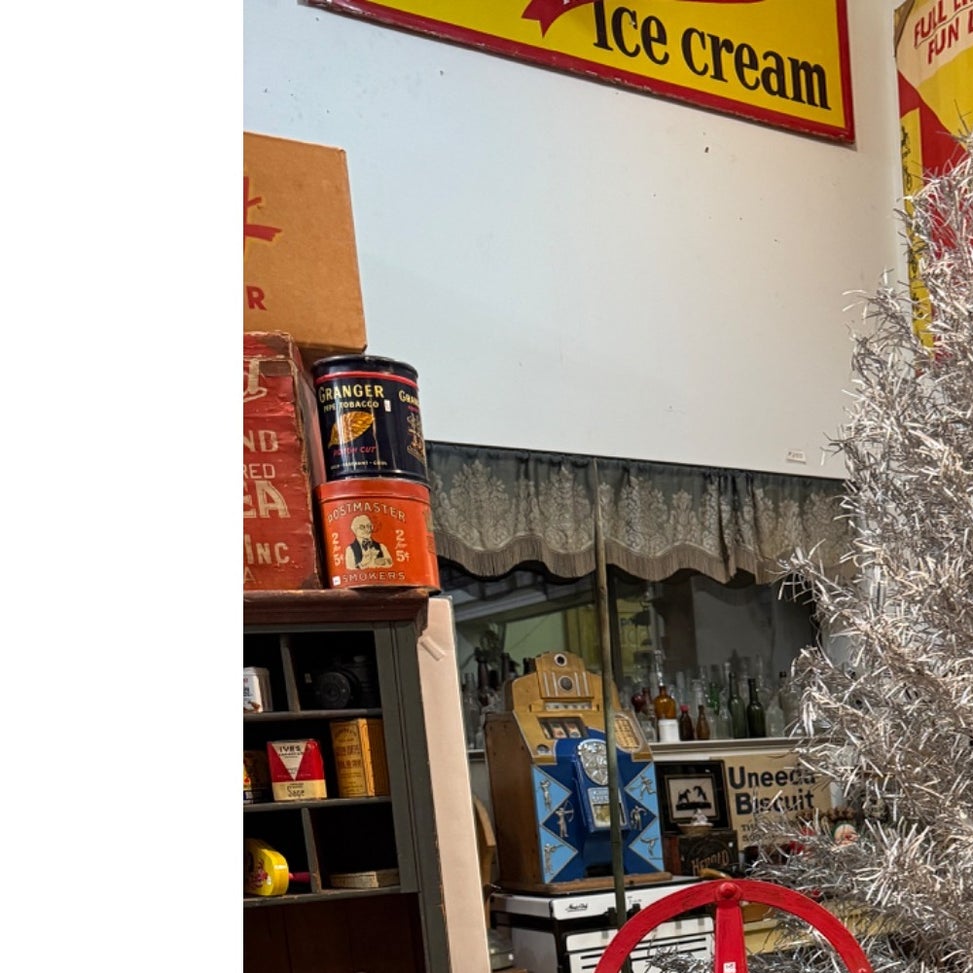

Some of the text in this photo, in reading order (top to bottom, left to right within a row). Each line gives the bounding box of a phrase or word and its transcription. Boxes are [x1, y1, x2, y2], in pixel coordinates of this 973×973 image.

[914, 0, 947, 49] FULL
[927, 17, 960, 64] FUN
[681, 27, 832, 111] cream
[318, 384, 384, 404] GRANGER
[340, 400, 380, 411] TOBACCO
[360, 446, 376, 454] CUT
[327, 502, 406, 525] POSTMASTER
[332, 532, 340, 545] 2
[395, 529, 405, 542] 2
[342, 571, 406, 583] SMOKERS
